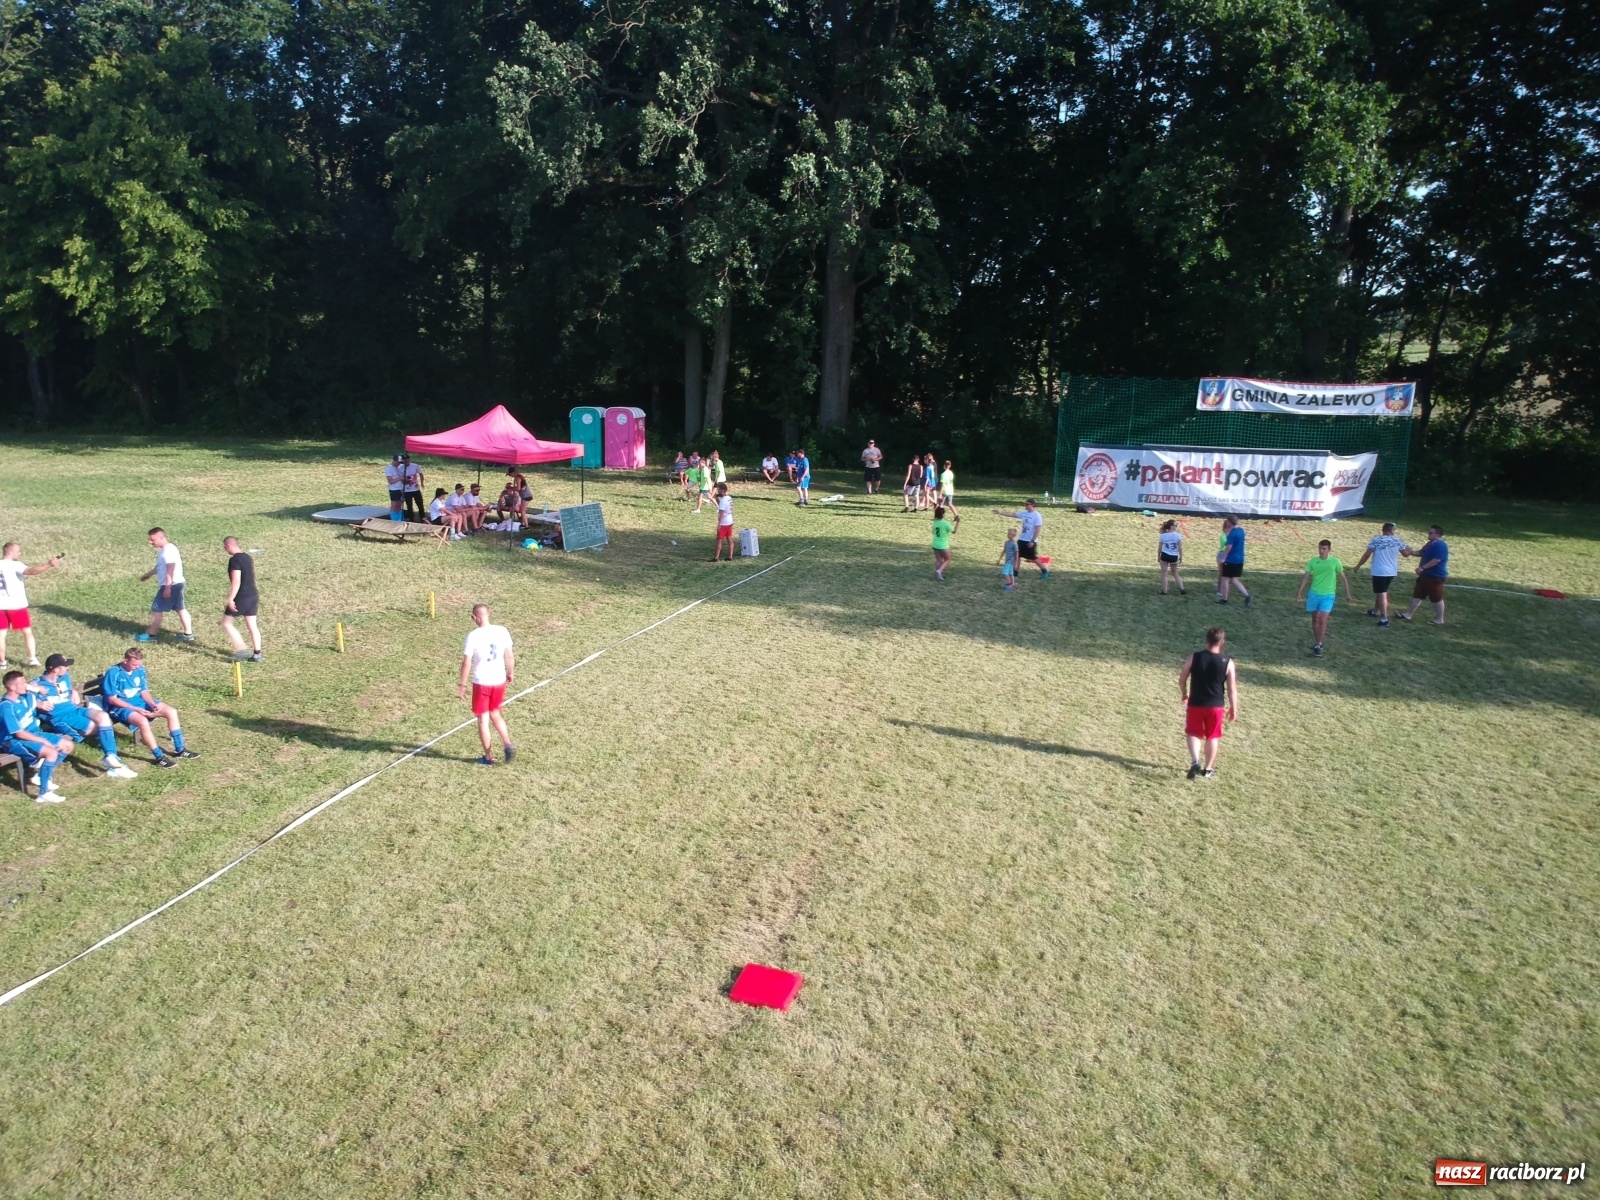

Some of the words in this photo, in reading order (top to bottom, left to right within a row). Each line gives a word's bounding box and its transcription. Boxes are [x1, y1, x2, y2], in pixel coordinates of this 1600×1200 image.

[1231, 388, 1290, 406] GMINA
[1295, 393, 1376, 407] ZALEWO
[1125, 458, 1327, 490] #palantpowrac
